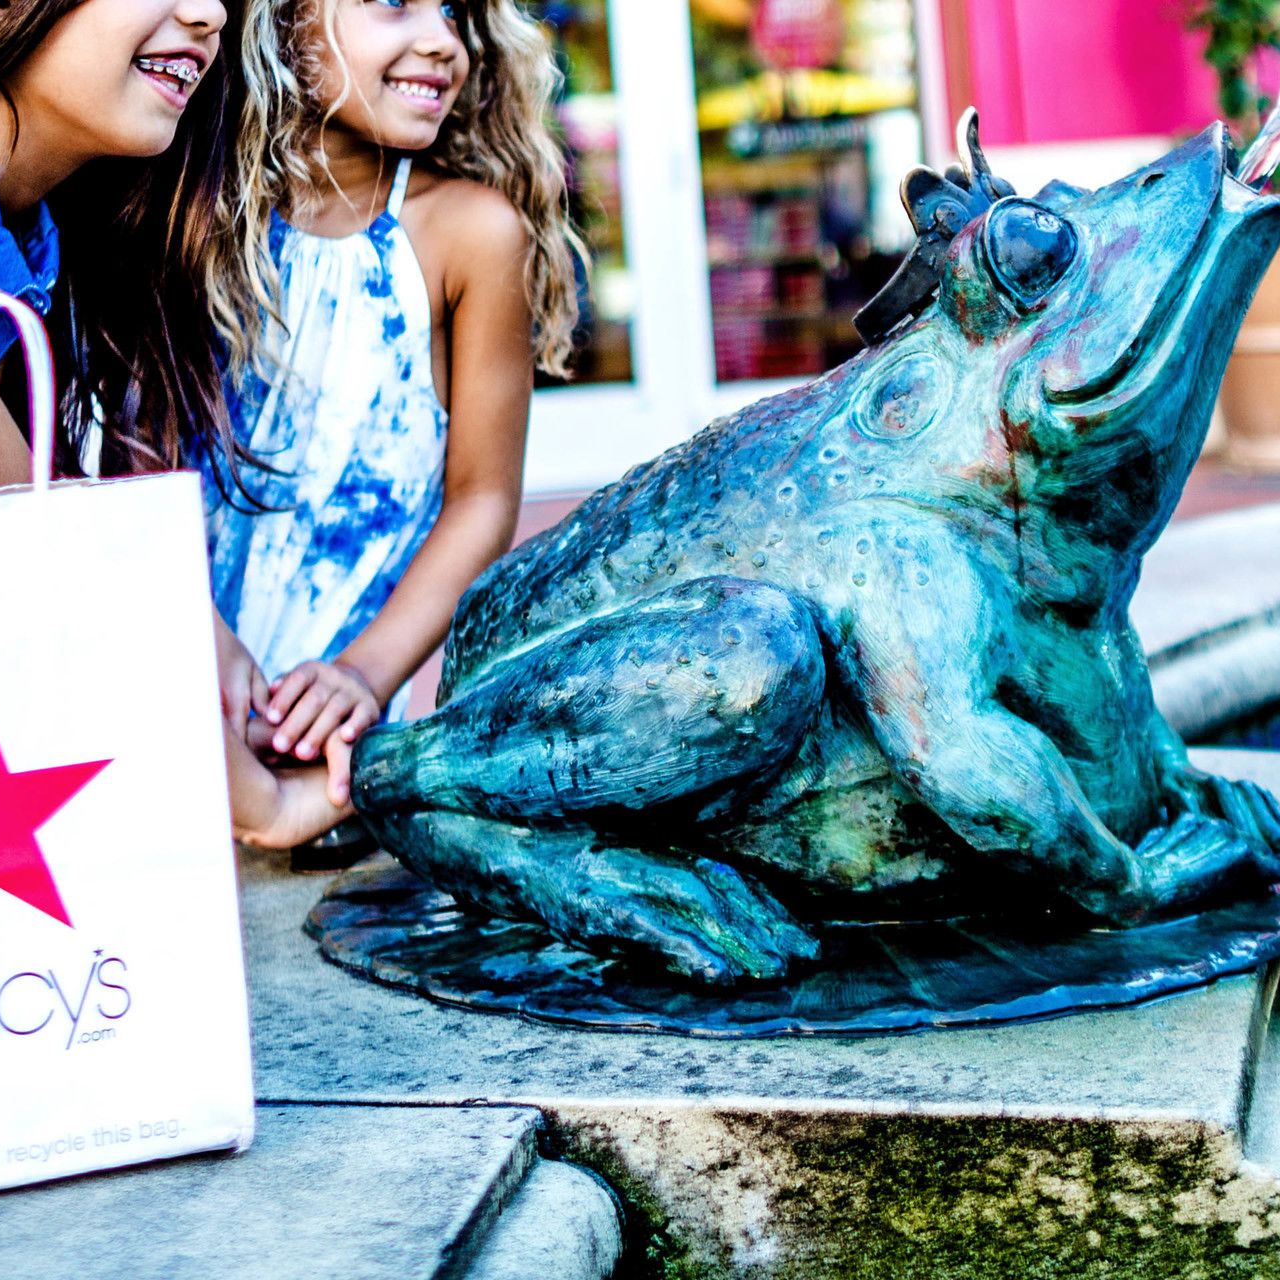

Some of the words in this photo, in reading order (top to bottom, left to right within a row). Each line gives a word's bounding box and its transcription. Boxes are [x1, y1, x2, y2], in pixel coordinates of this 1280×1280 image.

[5, 1132, 86, 1163] recycle
[92, 1123, 131, 1147] this
[138, 1116, 187, 1140] bag.
